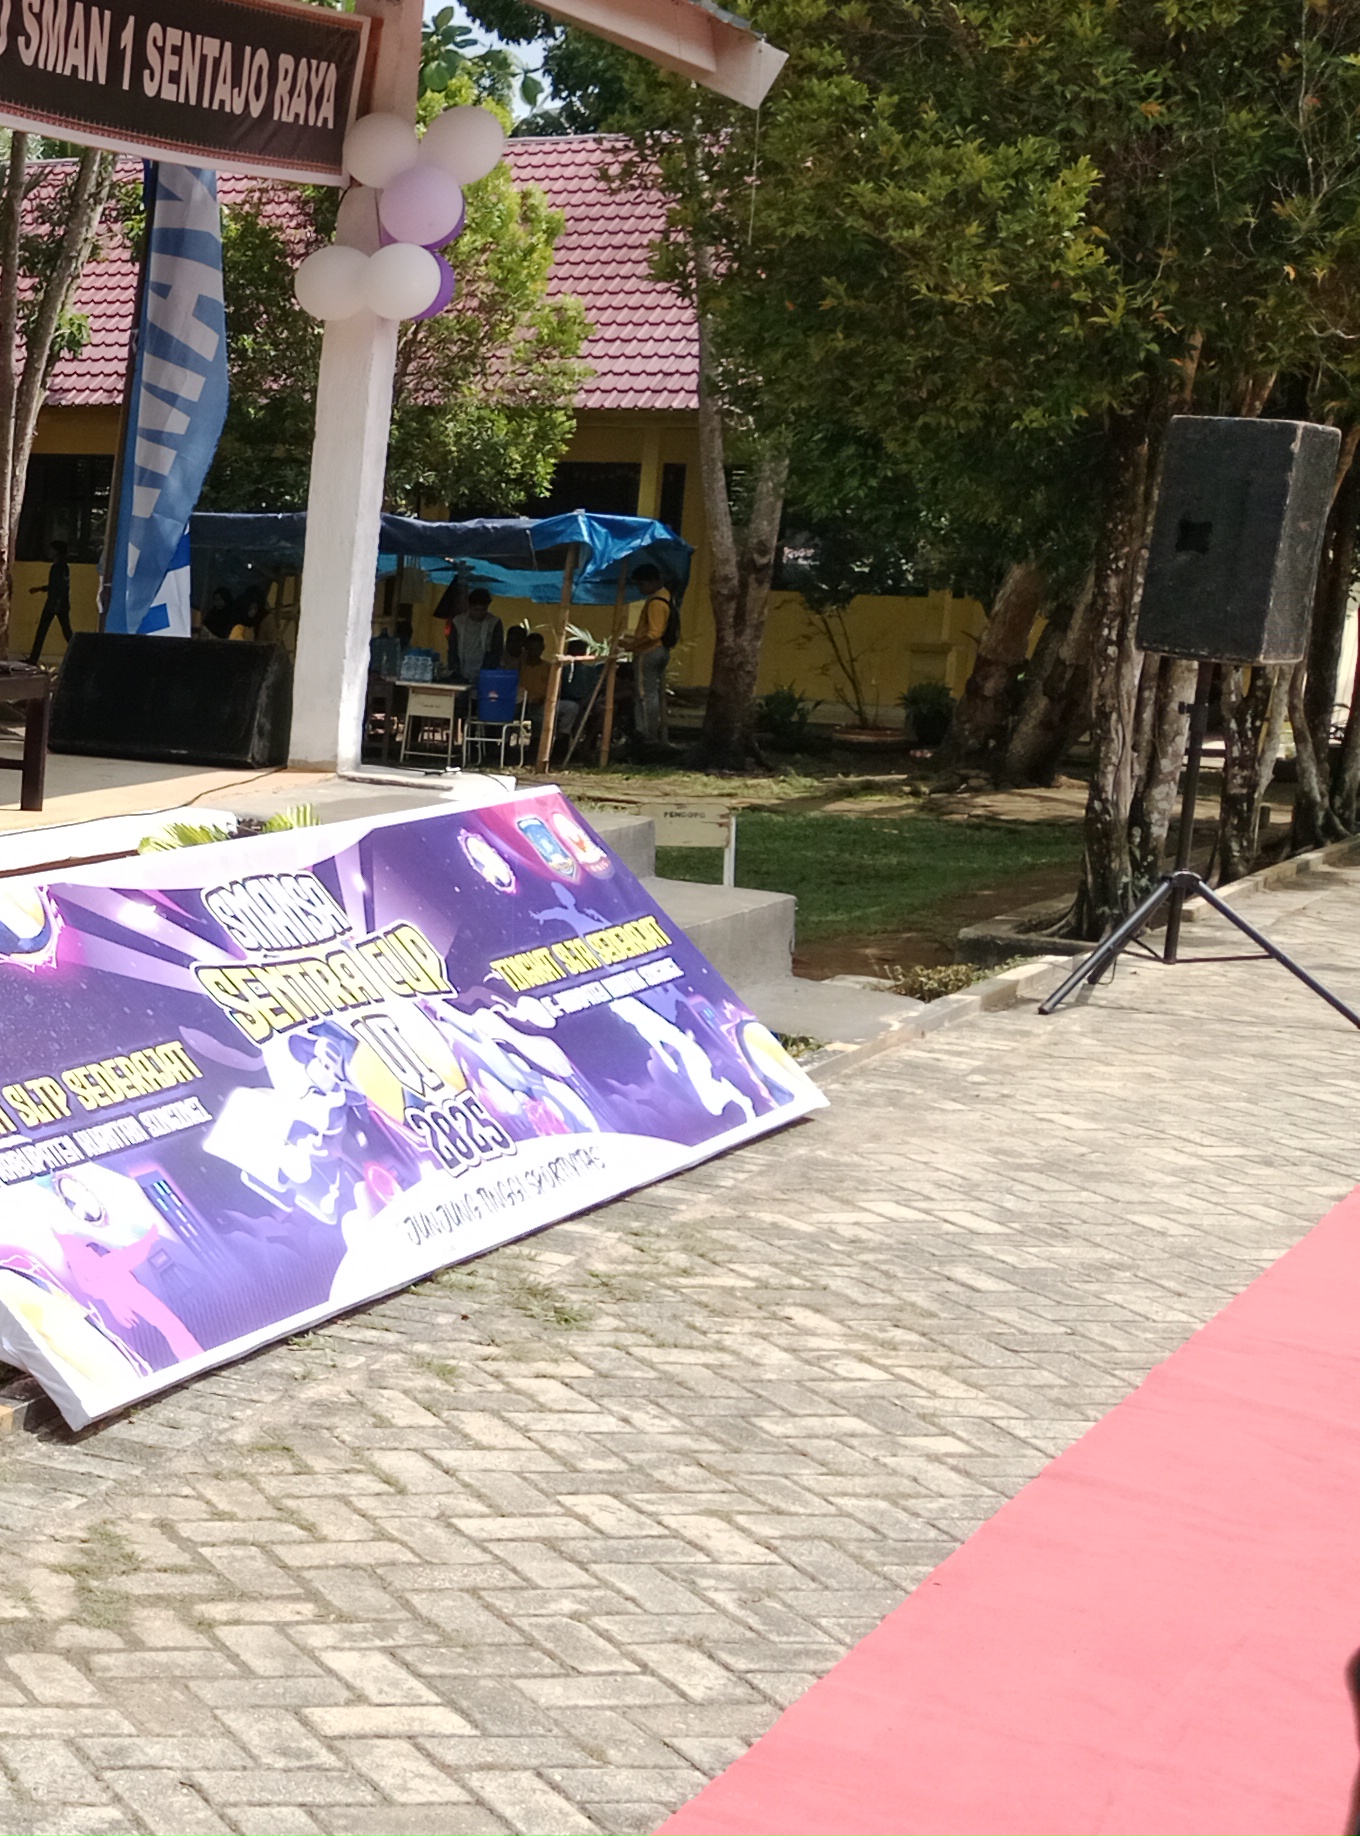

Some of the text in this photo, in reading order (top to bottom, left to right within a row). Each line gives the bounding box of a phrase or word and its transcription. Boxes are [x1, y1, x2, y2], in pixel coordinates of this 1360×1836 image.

[17, 0, 111, 85] SMAN
[120, 15, 135, 90] 1
[143, 22, 269, 118] SENTAJO
[273, 53, 337, 129] RAYA
[205, 873, 353, 951] SMANSA
[194, 922, 453, 1044] SENTRA CUP
[1, 1075, 73, 1129] SLTP
[61, 1040, 204, 1112] SEDERAJAT
[407, 1095, 515, 1172] 2025
